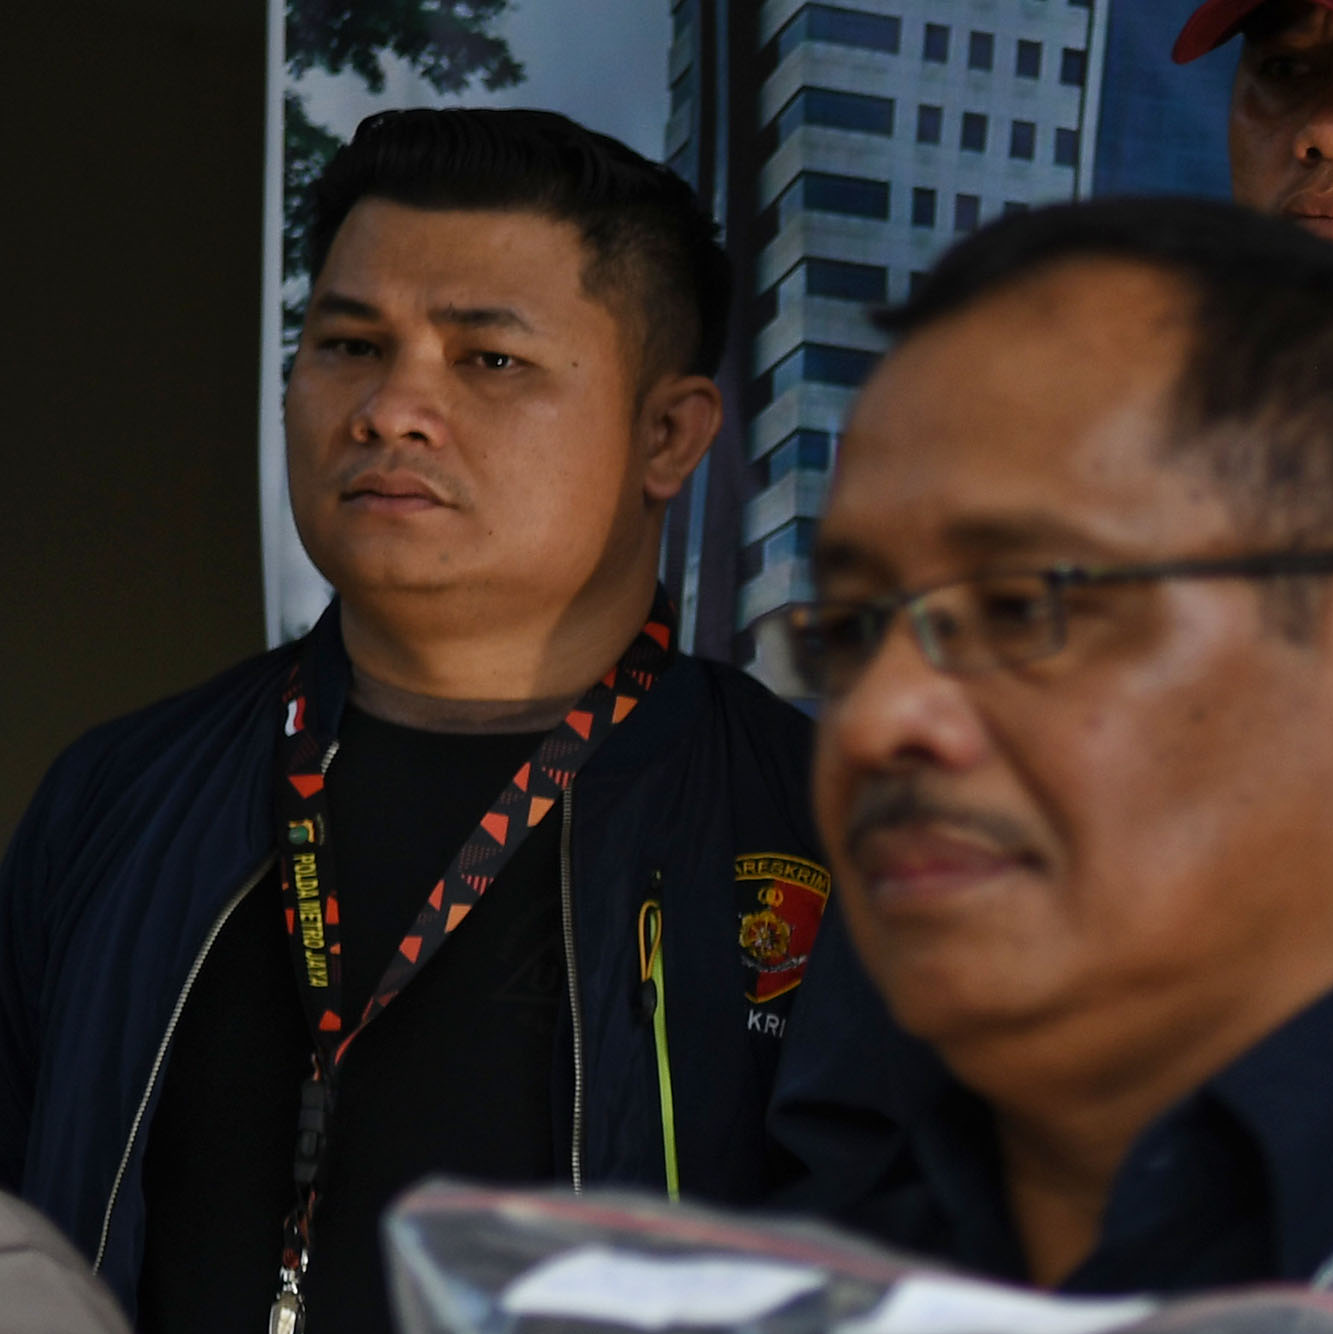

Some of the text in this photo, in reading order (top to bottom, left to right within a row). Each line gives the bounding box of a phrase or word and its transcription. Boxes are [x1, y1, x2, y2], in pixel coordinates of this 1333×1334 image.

[293, 853, 329, 987] POLDA METRO JAYA
